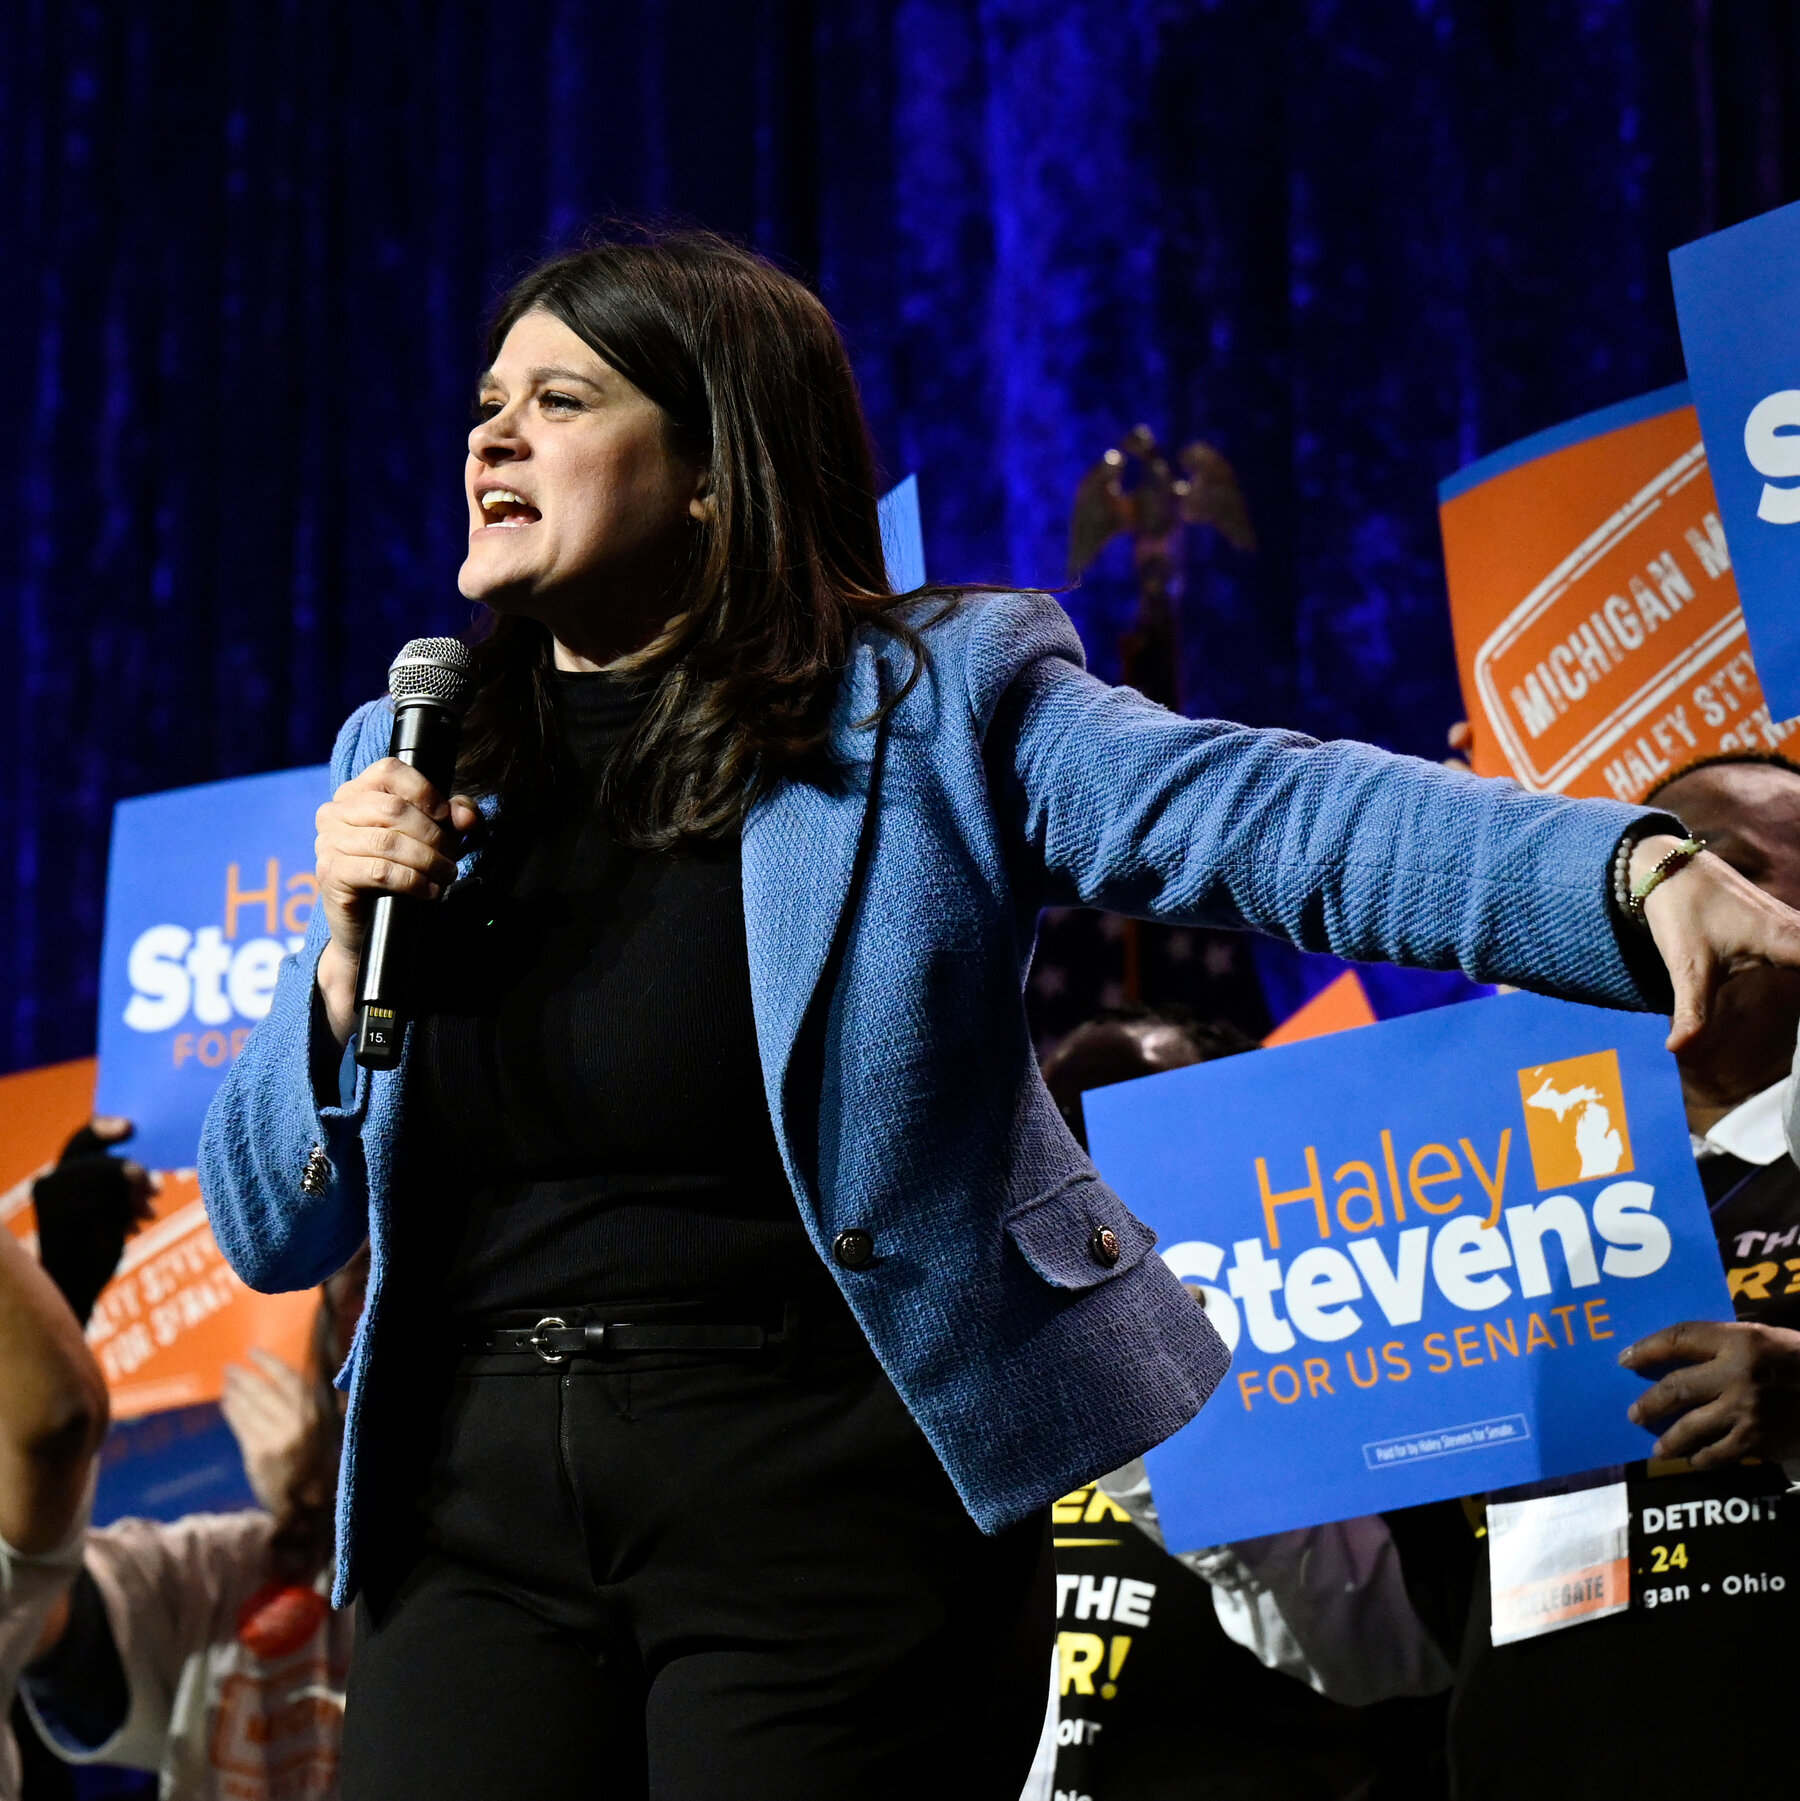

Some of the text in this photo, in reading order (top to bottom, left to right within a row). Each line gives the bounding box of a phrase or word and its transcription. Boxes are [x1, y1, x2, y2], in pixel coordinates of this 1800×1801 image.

[1511, 551, 1695, 739] MICHIGAN
[1604, 705, 1697, 800] HALEY
[123, 924, 304, 1032] Ste
[1254, 1128, 1512, 1249] Haley
[1160, 1180, 1672, 1354] Stevens
[1733, 1224, 1800, 1257] TH
[1237, 1299, 1614, 1411] FOR US SENATE
[1642, 1496, 1781, 1534] DETROIT
[1651, 1543, 1688, 1573] 24
[1056, 1574, 1157, 1628] THE
[1722, 1572, 1786, 1596] Ohio
